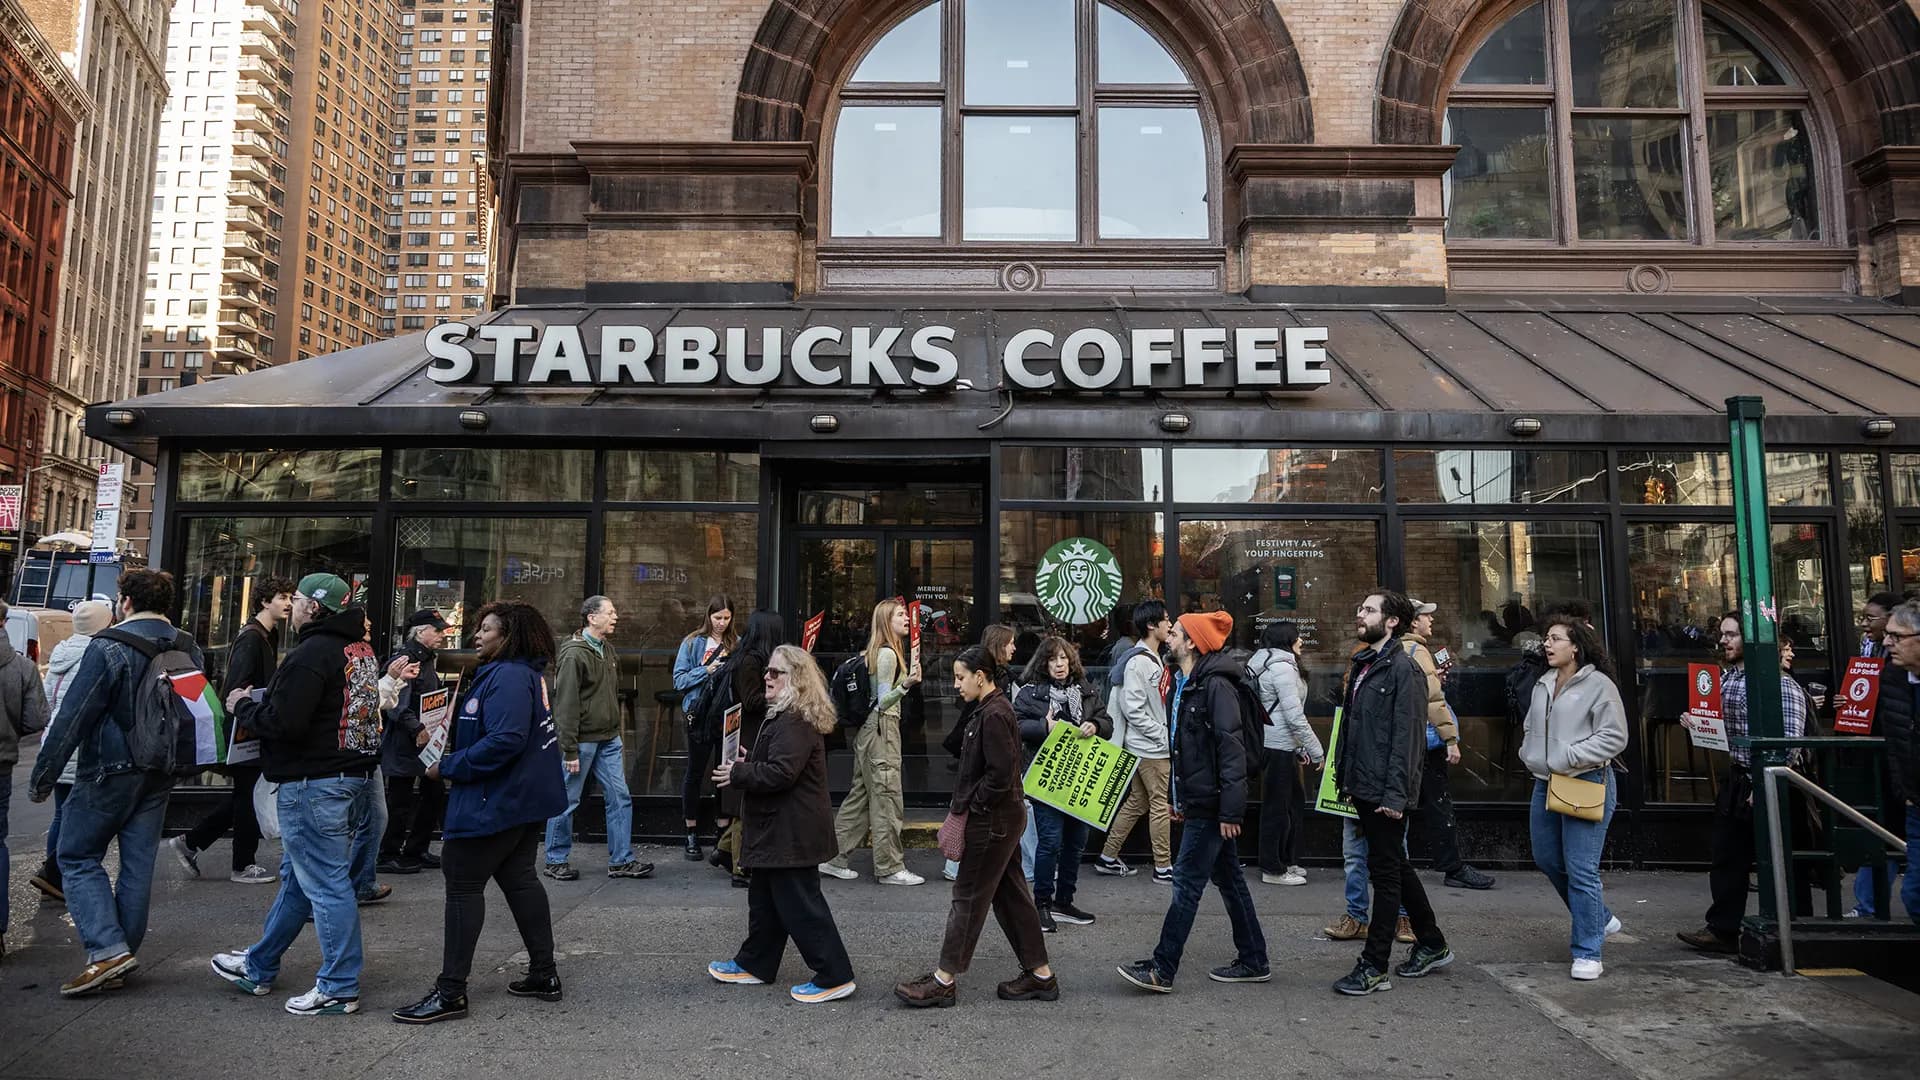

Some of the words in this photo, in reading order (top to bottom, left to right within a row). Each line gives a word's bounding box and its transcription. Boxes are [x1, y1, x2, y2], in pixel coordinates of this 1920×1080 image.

[424, 322, 959, 386] STARBUCKS
[1003, 327, 1332, 389] COFFEE
[1272, 550, 1324, 558] FINGERTIPS
[1691, 708, 1719, 717] CONTRACT
[1697, 726, 1718, 735] COFFEE
[1034, 747, 1050, 766] WE
[1038, 728, 1073, 787] SUPPORT
[1047, 737, 1076, 793] STARBUCKS
[1056, 743, 1080, 791] WORKERS
[1065, 752, 1083, 787] UNITED
[1067, 785, 1081, 807] RED
[1077, 760, 1091, 784] CUP
[1088, 738, 1101, 760] DAY
[1079, 751, 1109, 807] STRIKE!
